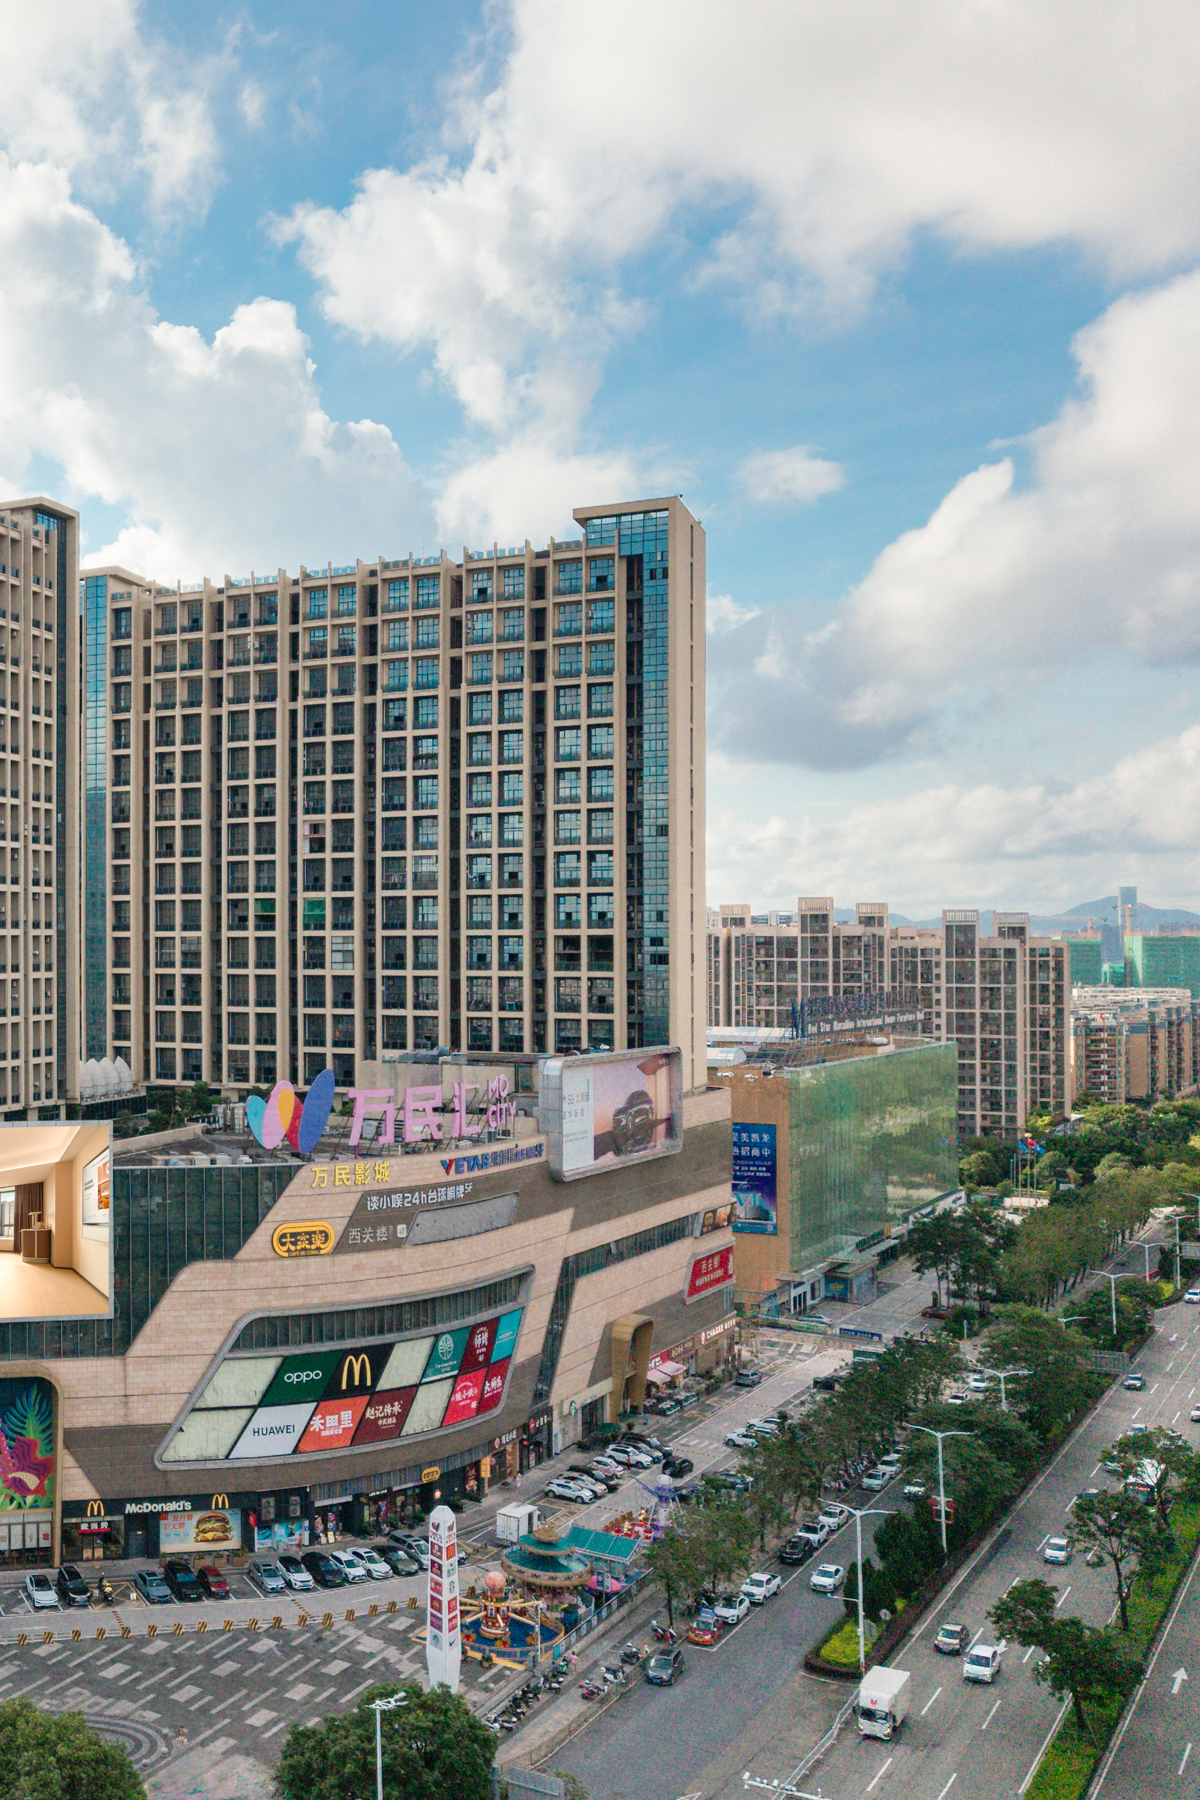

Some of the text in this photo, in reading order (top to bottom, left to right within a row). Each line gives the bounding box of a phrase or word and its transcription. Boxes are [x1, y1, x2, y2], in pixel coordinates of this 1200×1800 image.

[487, 1073, 510, 1099] MO
[347, 1082, 481, 1146] 万民汇
[487, 1101, 517, 1128] CITY
[311, 1160, 390, 1189] 万民影城
[440, 1152, 490, 1176] VETAS
[348, 1226, 389, 1245] 西关楼
[310, 1410, 353, 1432] 禾田里
[365, 1401, 403, 1420] 赵记传承
[252, 1424, 296, 1437] HUAWEI
[125, 1500, 192, 1514] McDonald's
